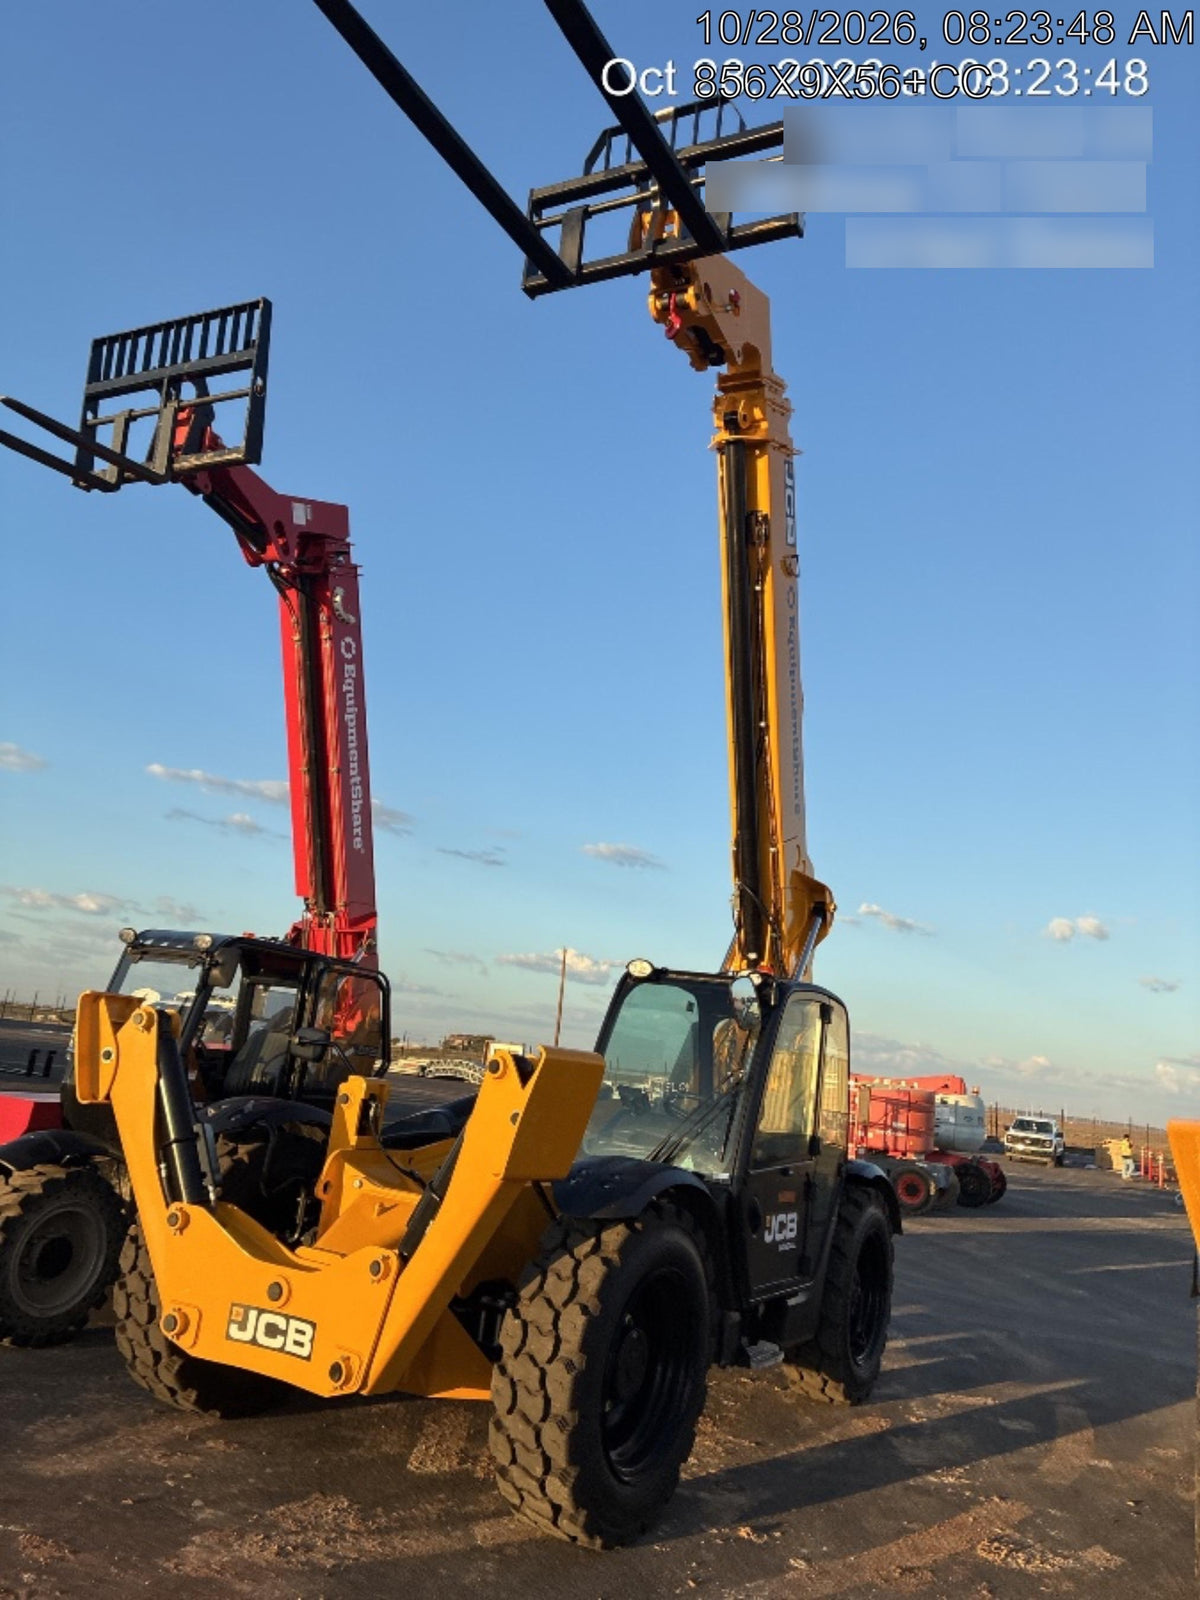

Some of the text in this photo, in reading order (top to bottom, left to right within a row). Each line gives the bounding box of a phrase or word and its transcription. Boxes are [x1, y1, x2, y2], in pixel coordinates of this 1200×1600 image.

[342, 663, 364, 851] EquipmentShare
[764, 1212, 797, 1243] JCB
[228, 1308, 314, 1358] JCB
